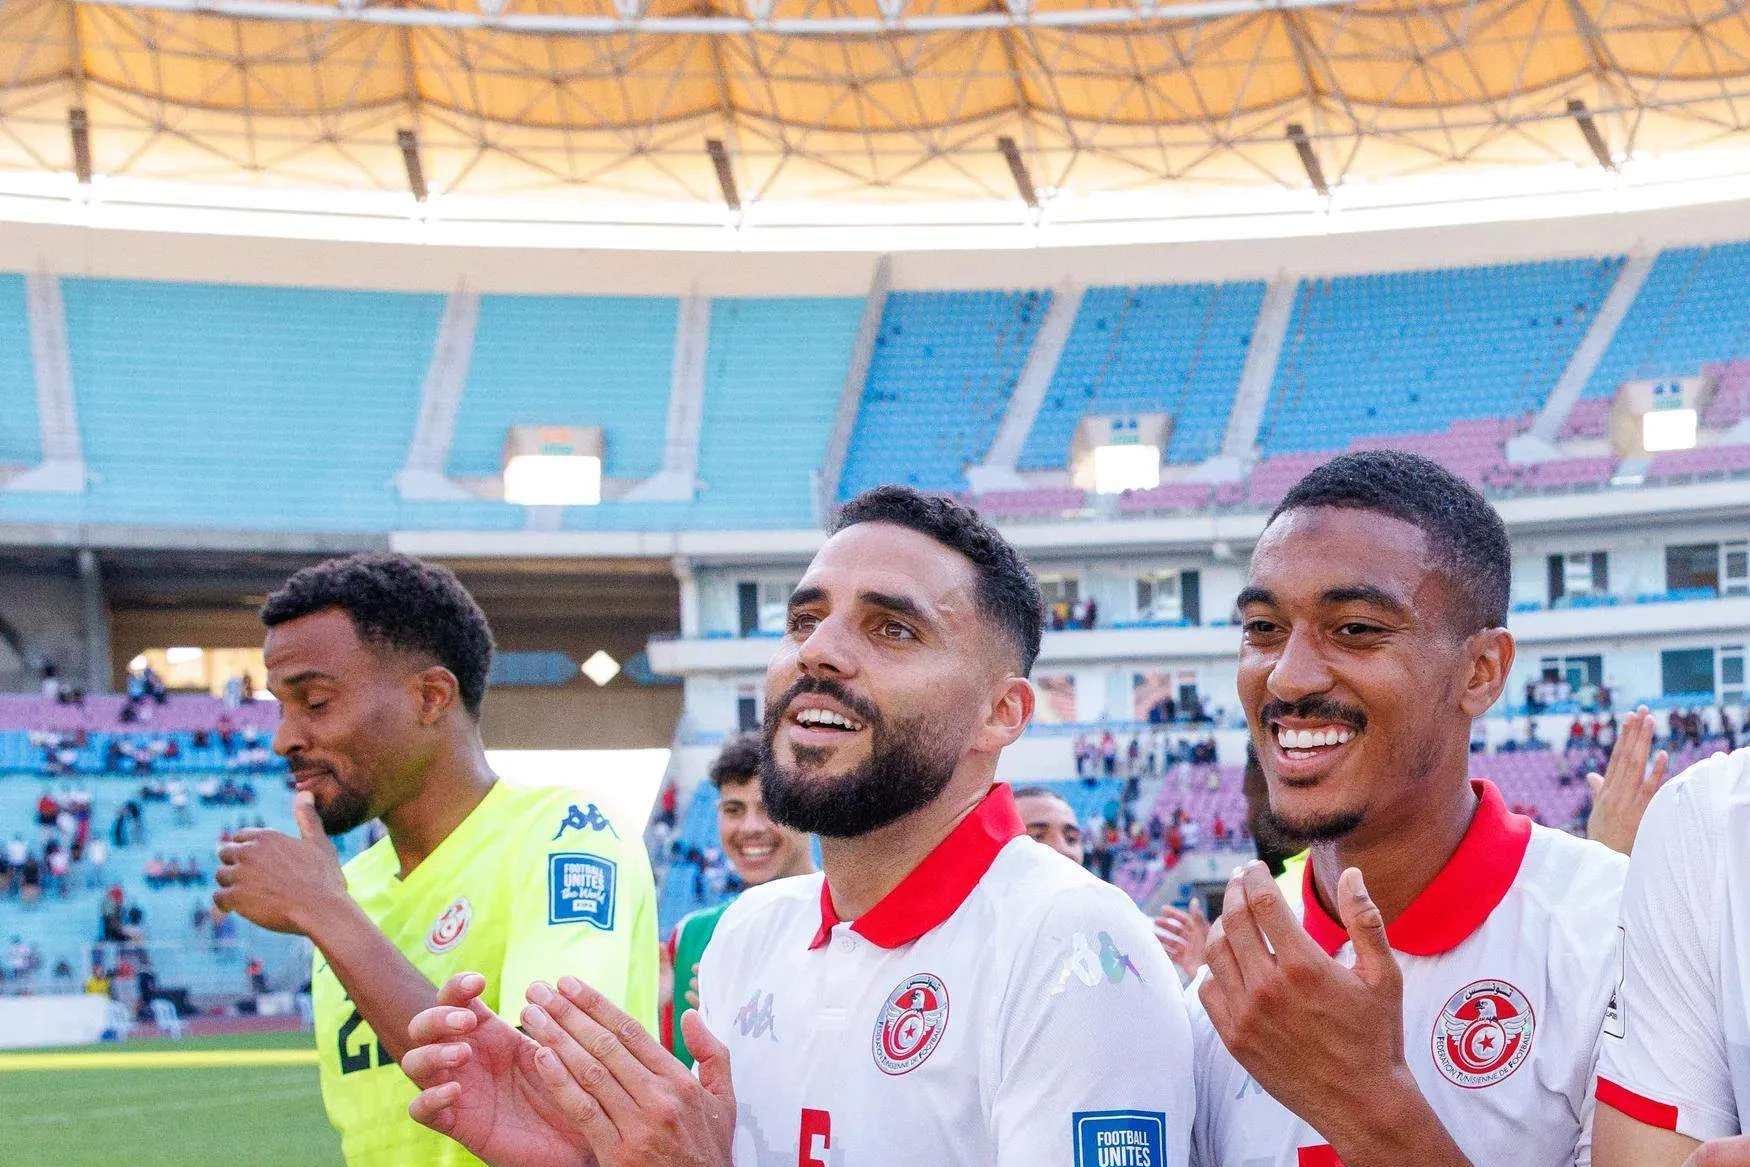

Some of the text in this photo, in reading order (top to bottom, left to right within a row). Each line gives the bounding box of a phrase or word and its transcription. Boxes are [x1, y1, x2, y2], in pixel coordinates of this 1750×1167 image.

[563, 873, 605, 891] UNITES
[339, 994, 398, 1074] 2
[1097, 1130, 1150, 1146] FOOTBALL
[1098, 1146, 1151, 1167] UNITES
